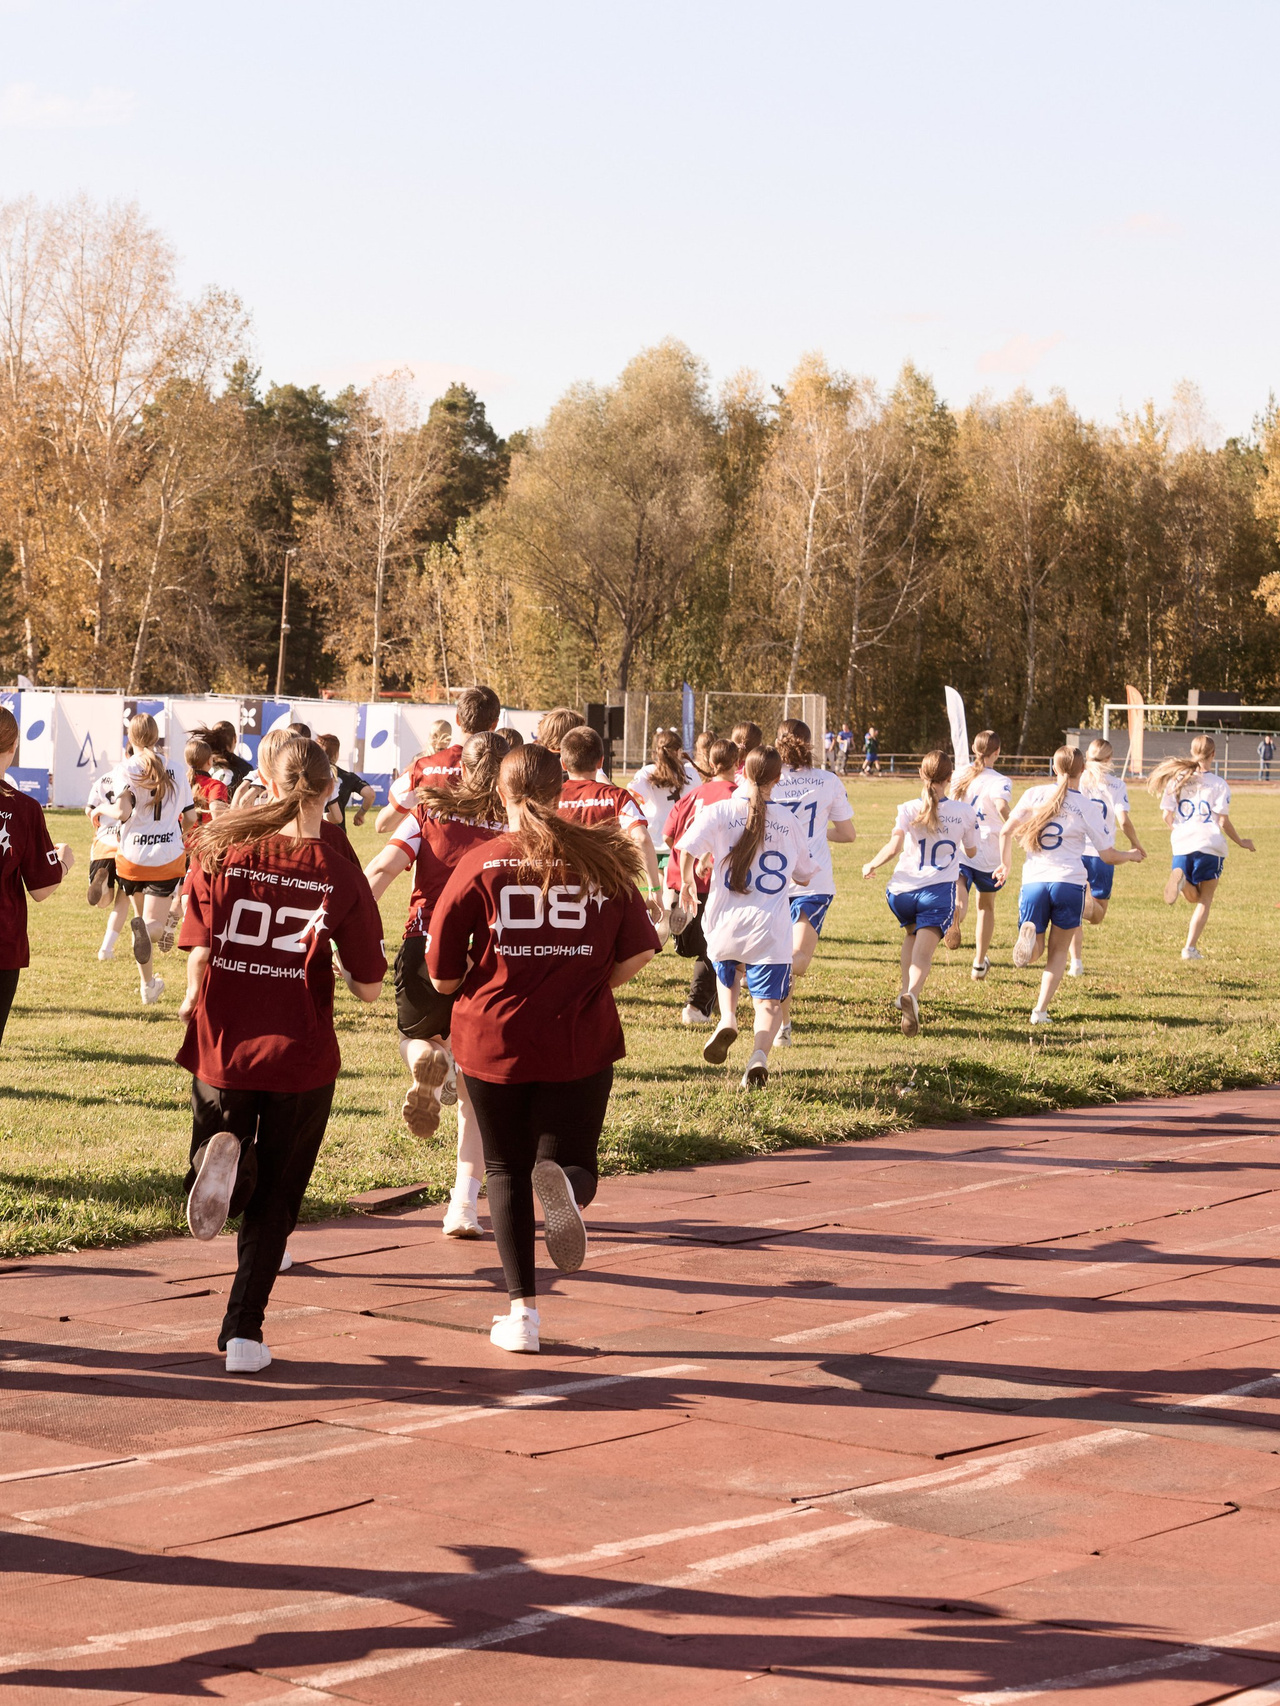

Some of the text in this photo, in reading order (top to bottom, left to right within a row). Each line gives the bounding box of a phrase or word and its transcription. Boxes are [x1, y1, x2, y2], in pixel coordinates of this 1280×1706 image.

[917, 837, 957, 871] 10
[224, 867, 334, 895] ДЕТСКИЕ УЛЫБКИ
[499, 884, 589, 930] 08
[227, 898, 321, 953] 02
[212, 955, 247, 973] НАШЕ
[494, 944, 593, 957] НАШЕ ОРУЖИЕ!
